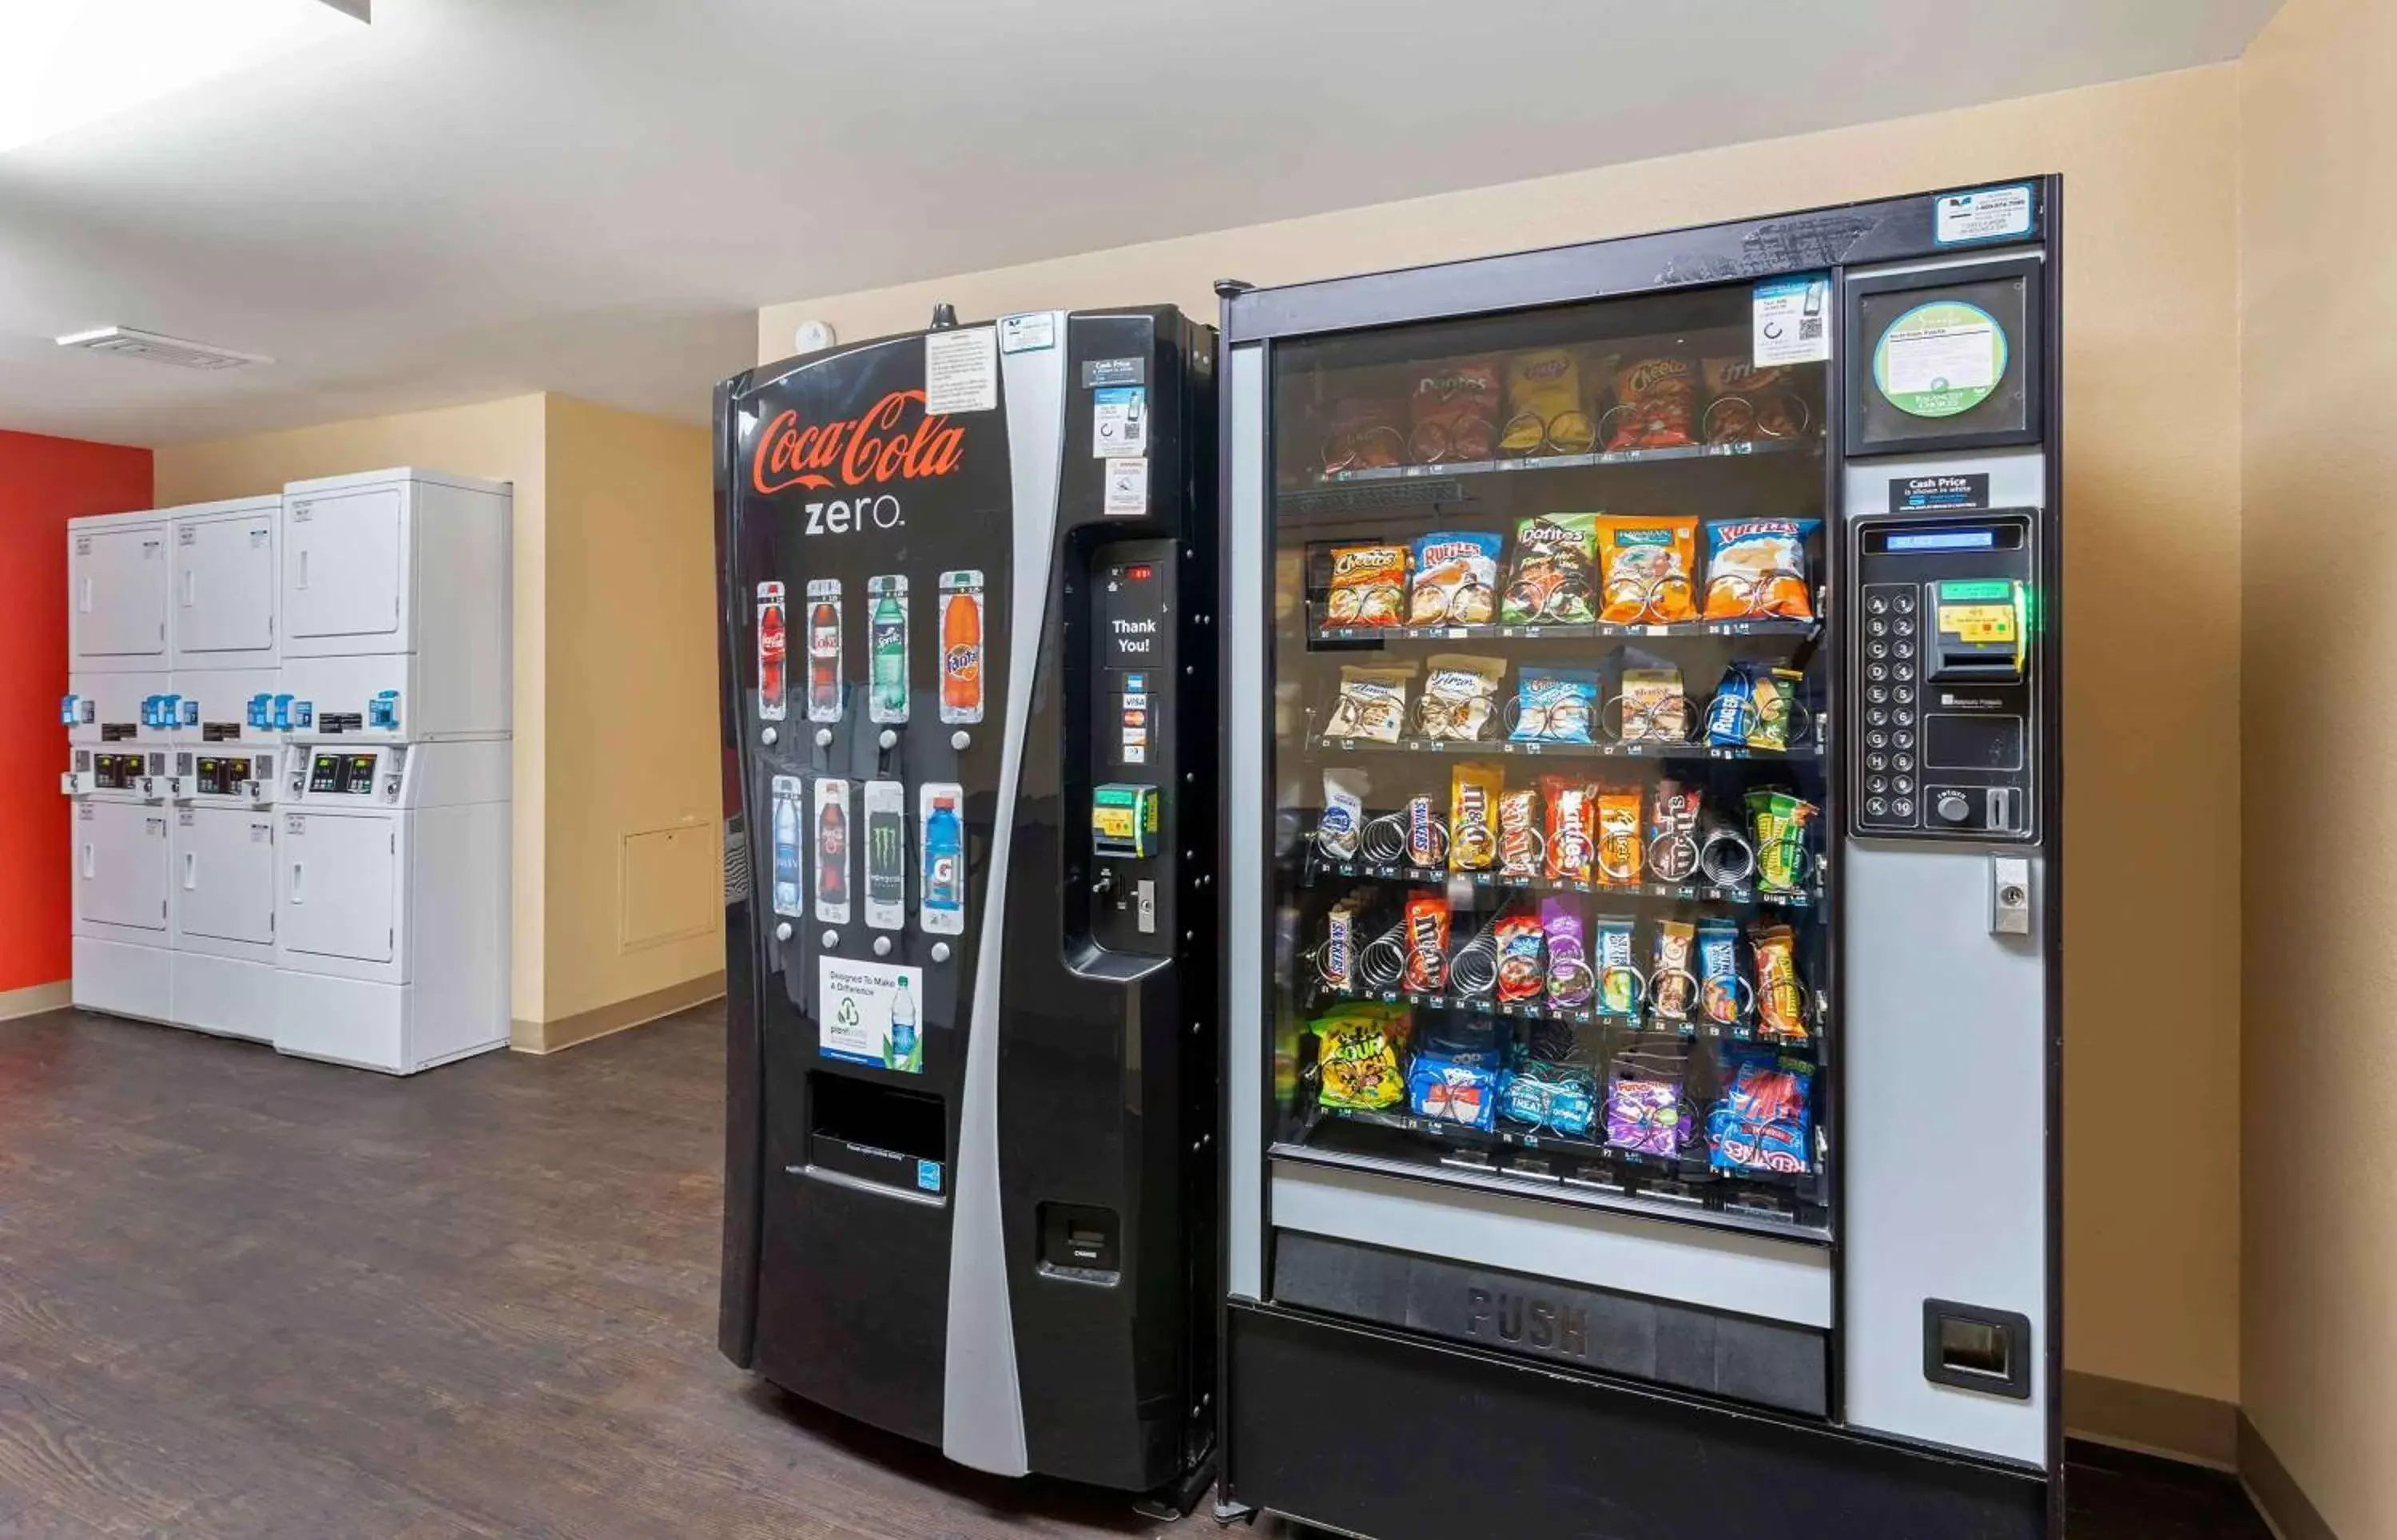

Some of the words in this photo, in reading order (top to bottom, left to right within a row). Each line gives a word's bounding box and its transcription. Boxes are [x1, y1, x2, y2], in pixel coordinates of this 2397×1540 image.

[1909, 479, 1935, 488] Cash
[1938, 478, 1966, 487] Price
[1423, 542, 1481, 565] RUFFLES
[1334, 552, 1397, 575] Cheetos
[1112, 620, 1156, 634] Thank
[1119, 639, 1150, 653] You!
[1126, 697, 1145, 706] VISA
[1413, 801, 1429, 851] SNICKERS
[829, 971, 862, 984] Designed
[865, 975, 873, 984] To
[874, 977, 896, 987] Make
[837, 982, 875, 996] Difference
[1335, 1038, 1381, 1061] SOUR
[1466, 1286, 1588, 1359] PUSH
